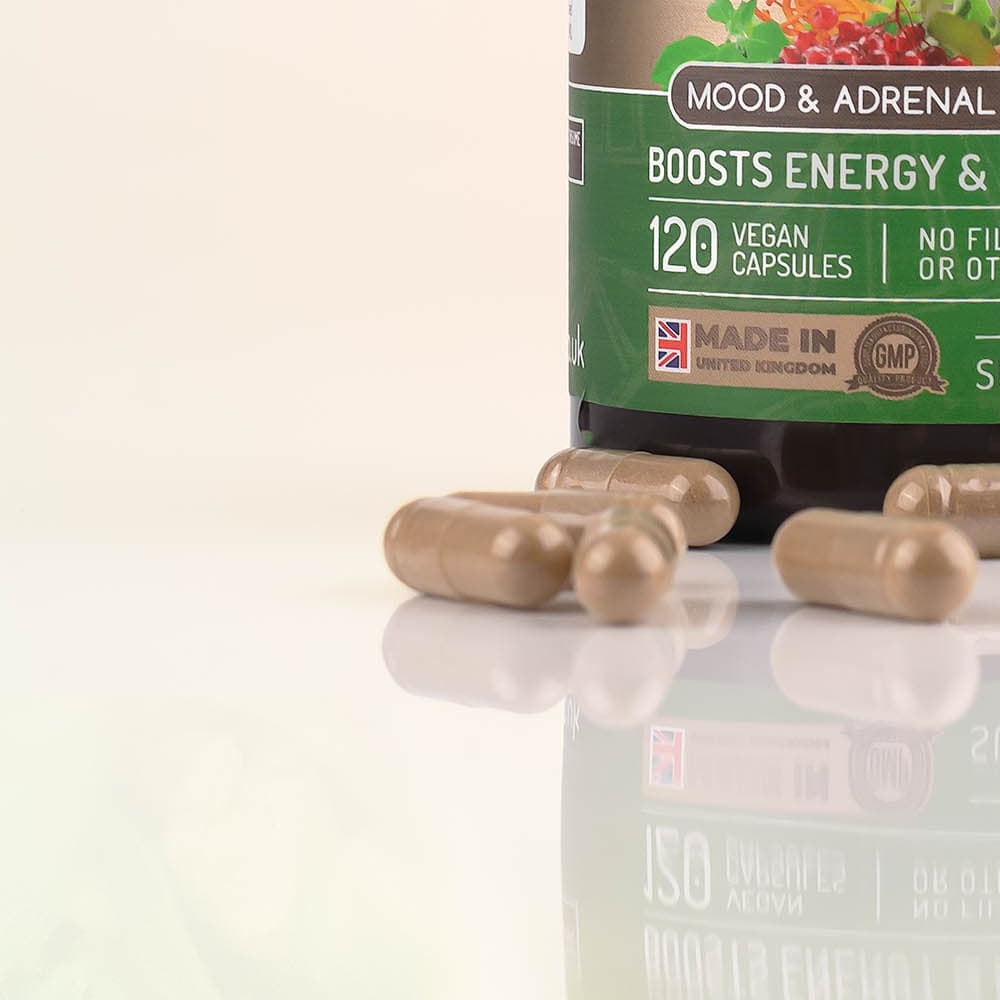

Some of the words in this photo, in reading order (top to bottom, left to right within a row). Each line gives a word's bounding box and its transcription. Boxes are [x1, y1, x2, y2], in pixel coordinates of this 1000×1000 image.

[687, 82, 785, 113] MOOD
[798, 85, 819, 113] &
[834, 85, 996, 115] ADRENAL
[648, 147, 772, 187] BOOSTS
[786, 152, 945, 191] ENERGY
[959, 153, 987, 191] &
[649, 215, 717, 274] 120
[732, 223, 808, 248] VEGAN
[919, 227, 954, 251] NO
[732, 253, 852, 278] CAPSULES
[919, 256, 954, 281] OR
[695, 323, 789, 352] MADE
[800, 329, 836, 354] IN
[696, 355, 751, 373] UNITED
[755, 359, 837, 376] KINGDOM
[875, 343, 916, 369] GMP
